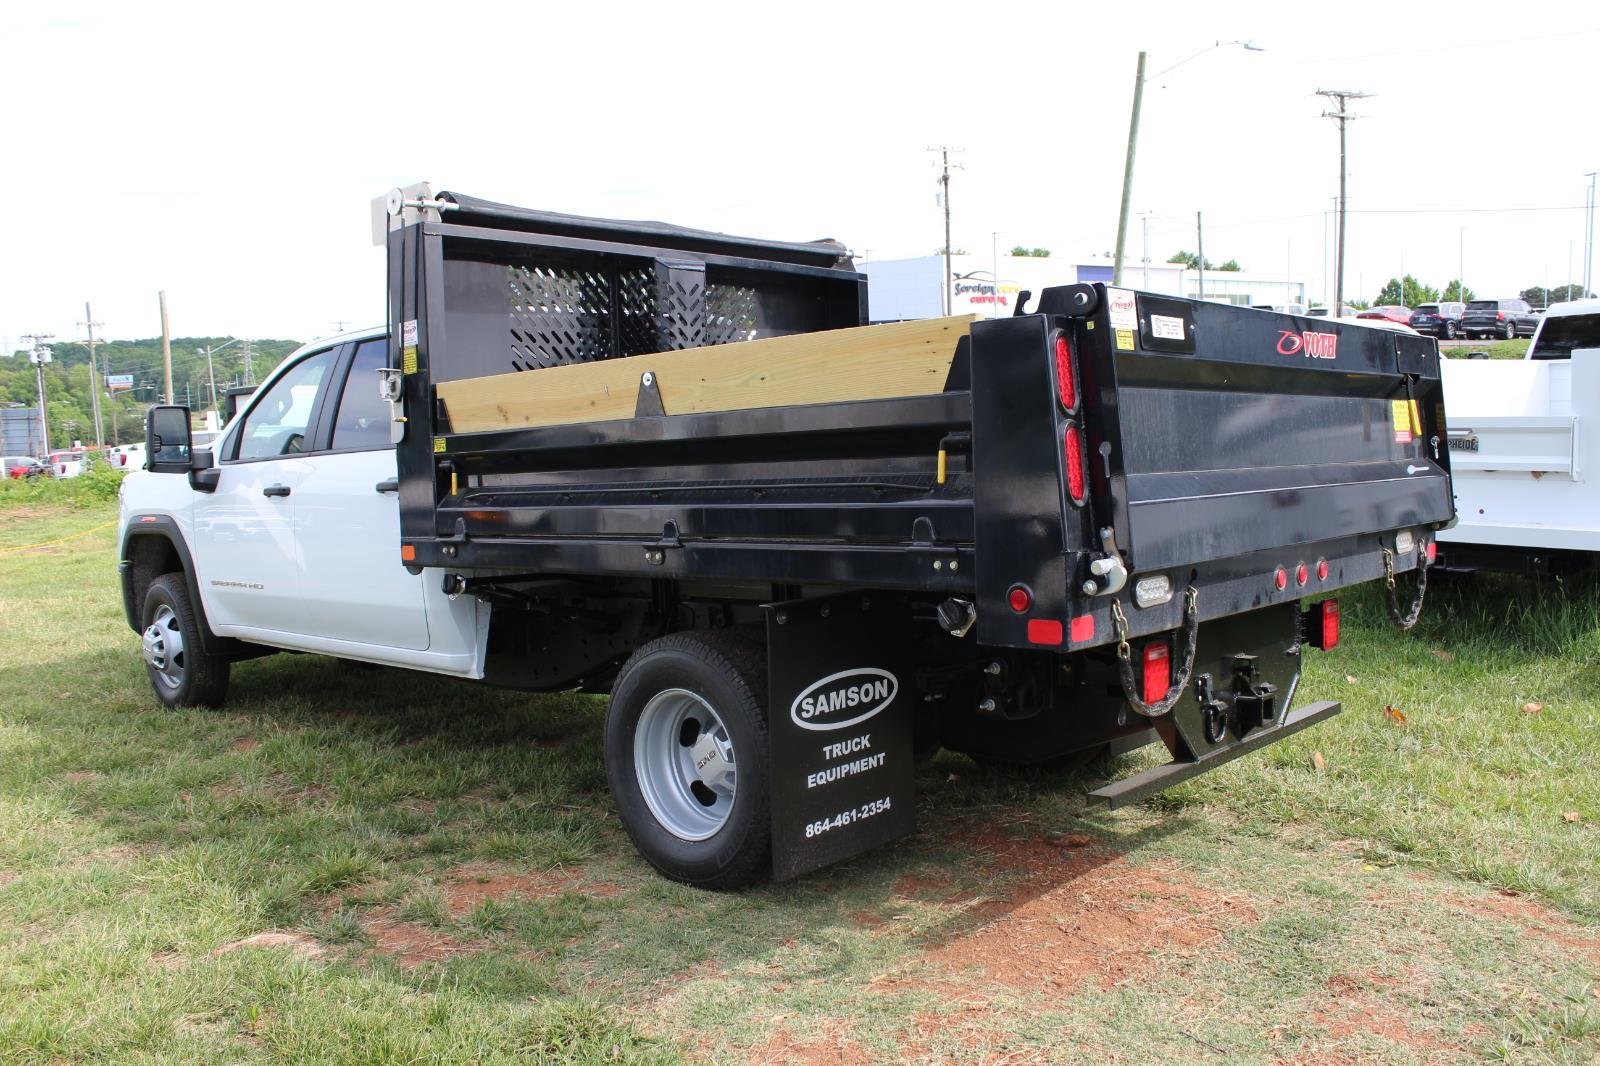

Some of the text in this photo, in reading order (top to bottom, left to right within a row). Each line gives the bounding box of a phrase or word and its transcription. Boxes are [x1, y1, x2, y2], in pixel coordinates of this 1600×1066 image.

[1302, 331, 1338, 359] VOTH
[800, 678, 889, 719] SAMSON
[822, 733, 872, 760] TRUCK
[806, 752, 886, 789] EQUIPMENT
[805, 796, 891, 839] 864-461-2354
